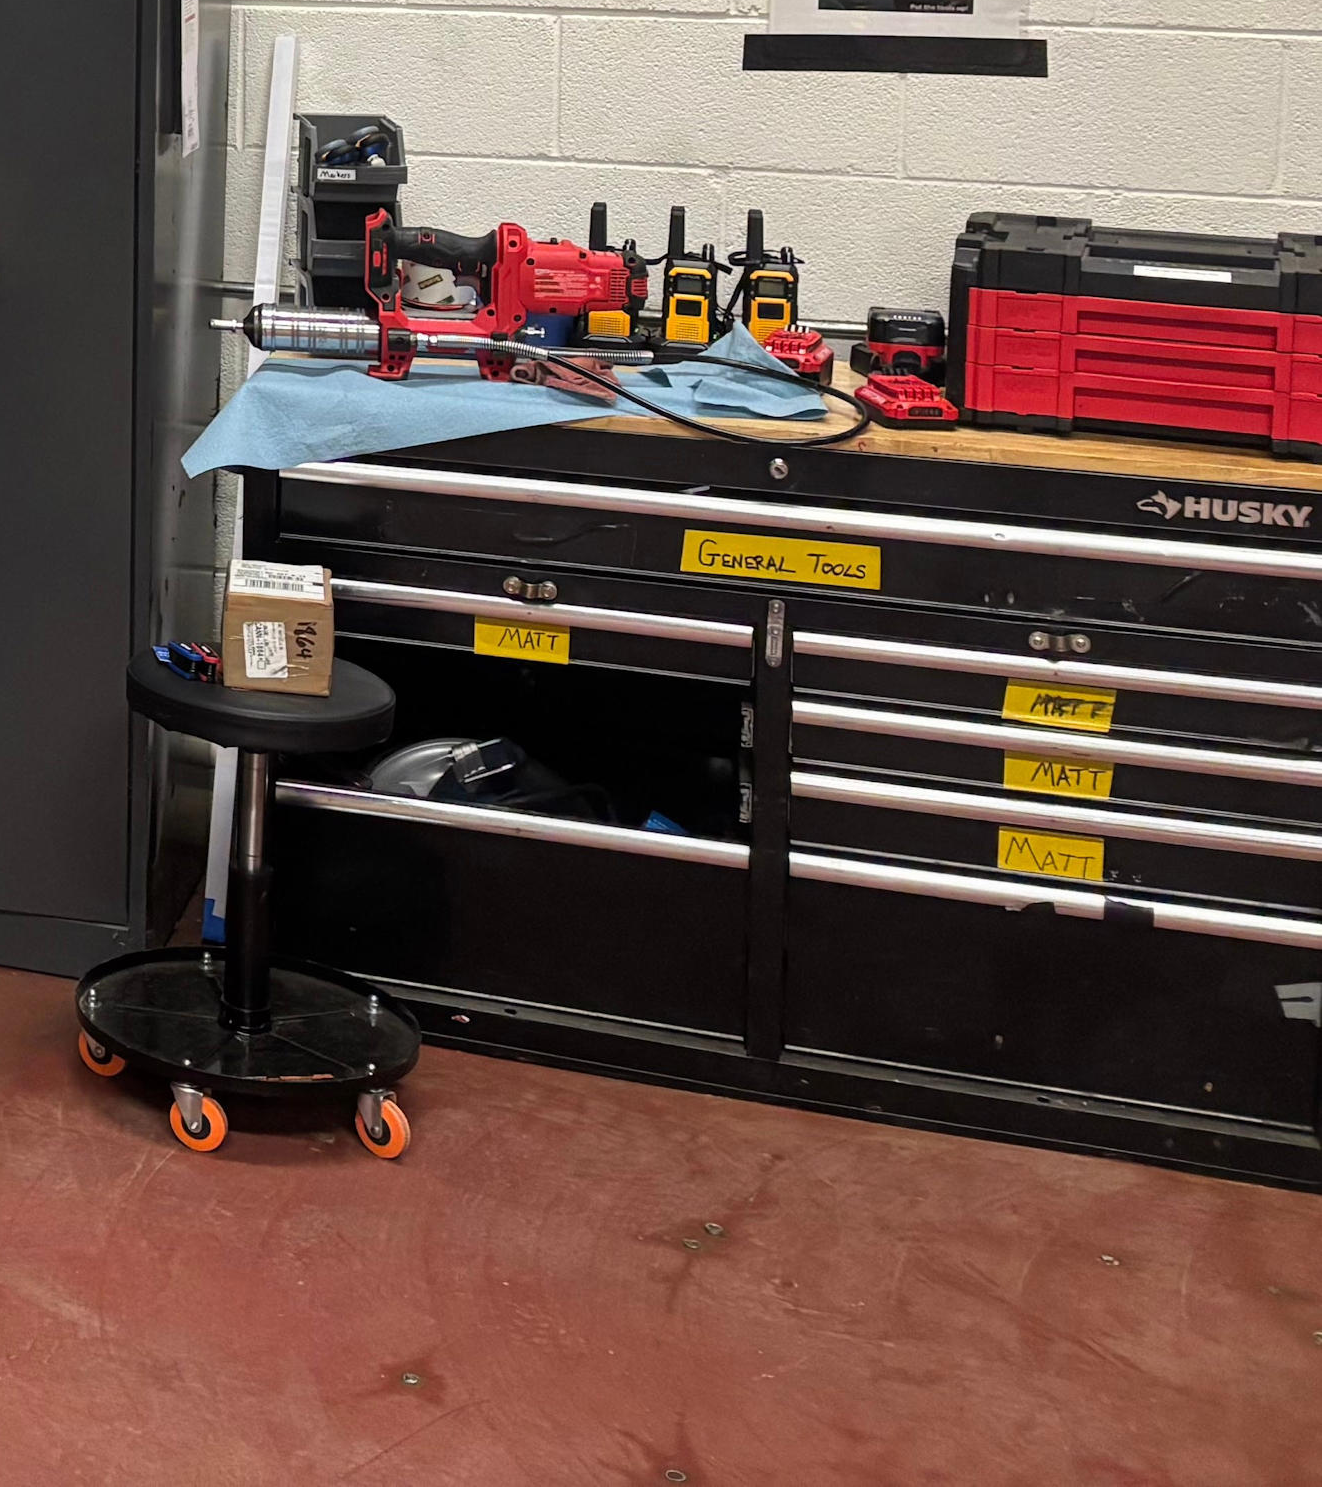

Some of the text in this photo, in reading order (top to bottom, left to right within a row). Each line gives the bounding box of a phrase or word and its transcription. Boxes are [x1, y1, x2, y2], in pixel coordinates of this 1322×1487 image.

[1183, 496, 1312, 528] HUSKY
[698, 539, 867, 580] GENERAL TOOLS
[293, 621, 318, 659] 1864
[498, 626, 559, 652] MATT
[1031, 761, 1106, 791] MATT
[1005, 836, 1097, 880] MATT
